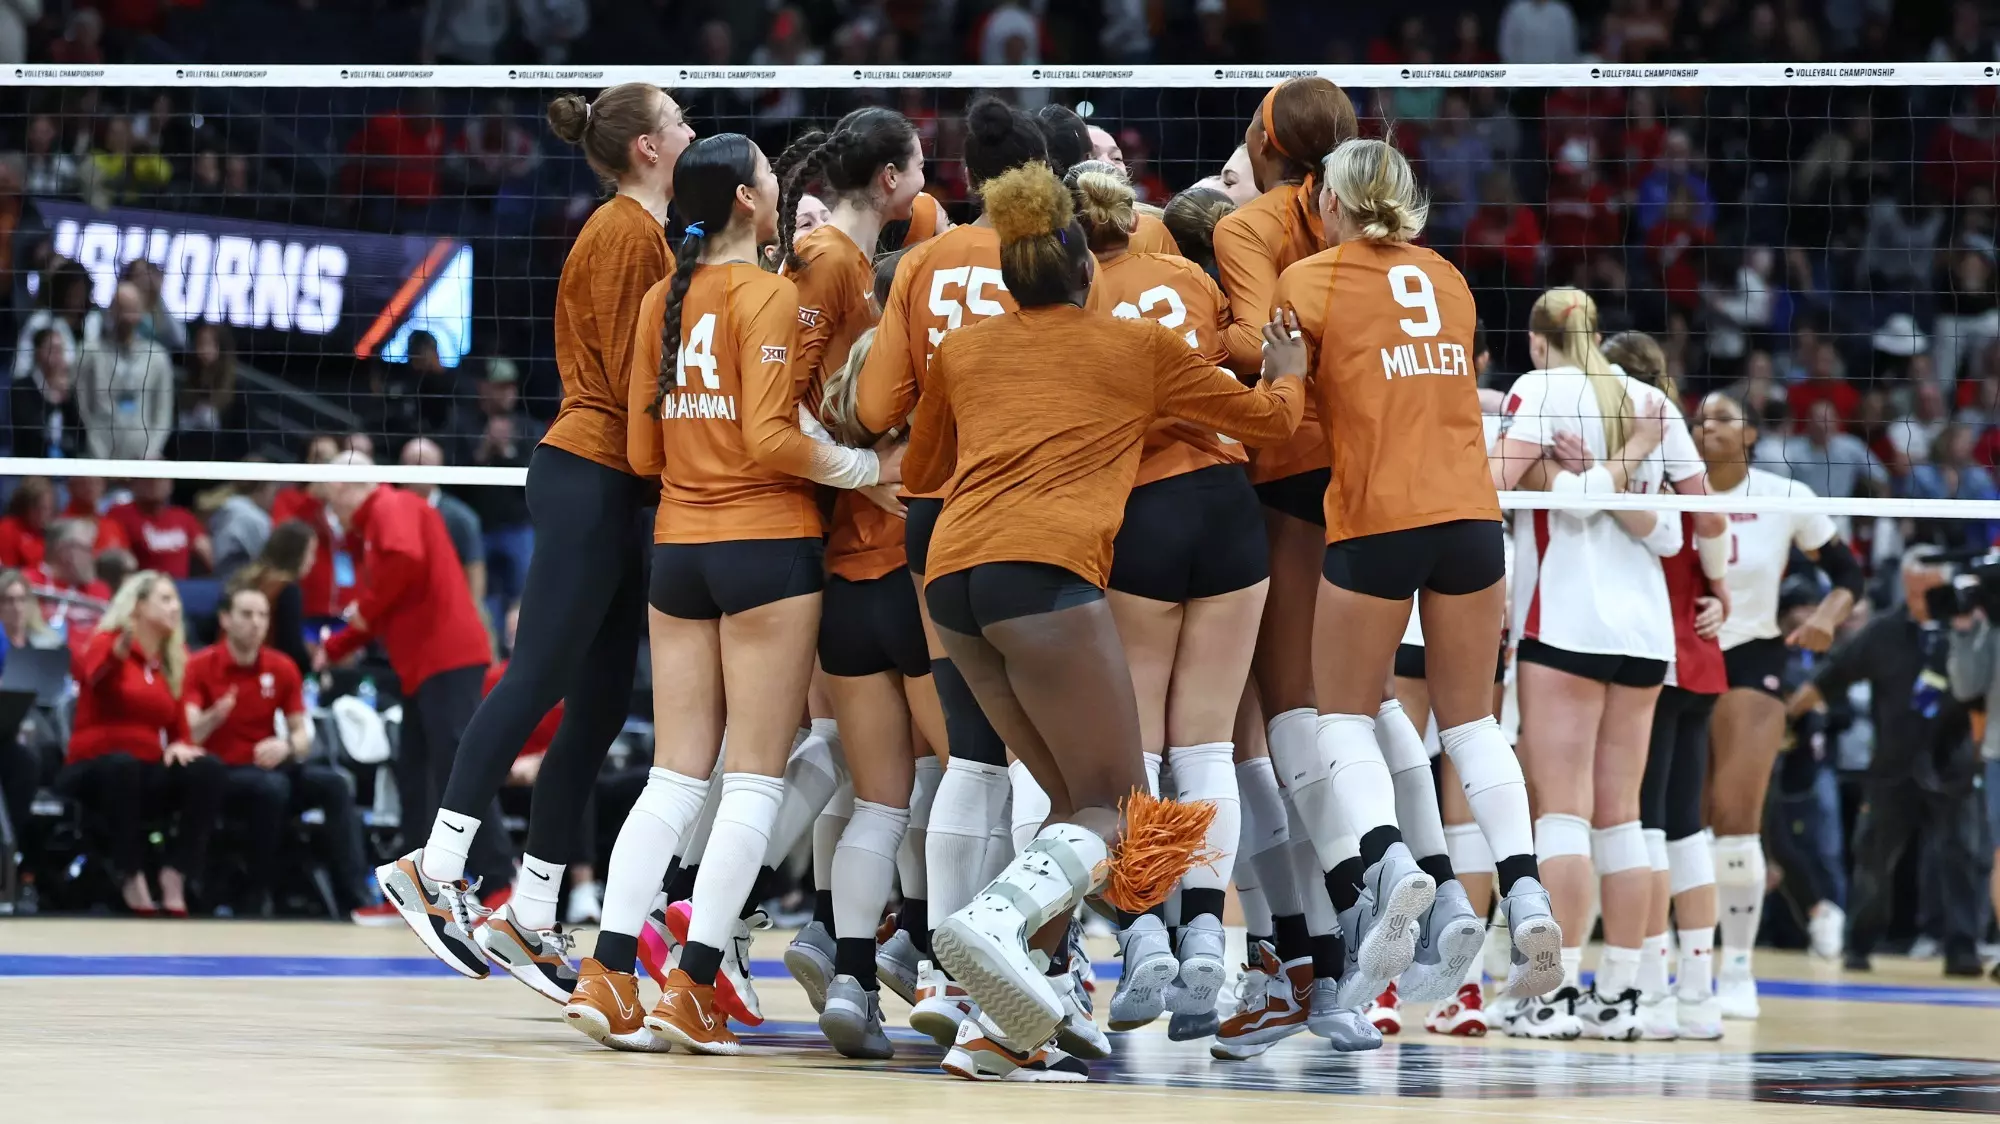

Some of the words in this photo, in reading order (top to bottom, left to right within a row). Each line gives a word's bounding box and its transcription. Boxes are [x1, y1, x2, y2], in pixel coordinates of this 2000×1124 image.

[185, 70, 219, 78] VOLLEYBALL
[518, 71, 554, 79] VOLLEYBALL
[556, 71, 604, 79] CHAMPIONSHIP
[689, 71, 726, 79] VOLLEYBALL
[727, 71, 776, 79] CHAMPIONSHIP
[863, 71, 901, 79] VOLLEYBALL
[903, 71, 952, 79] CHAMPIONSHIP
[1042, 70, 1080, 79] VOLLEYBALL
[1082, 71, 1133, 79] CHAMPIONSHIP
[1225, 70, 1264, 79] VOLLEYBALL
[1266, 70, 1318, 78] CHAMPIONSHIP
[1412, 70, 1452, 79] VOLLEYBALL
[1453, 70, 1506, 78] CHAMPIONSHIP
[1601, 69, 1643, 78] VOLLEYBALL
[1644, 69, 1699, 78] CHAMPIONSHIP
[1796, 68, 1837, 77] VOLLEYBALL
[1839, 68, 1895, 77] CHAMPIONSHIP
[1387, 264, 1442, 337] 9
[1111, 284, 1199, 349] 2
[762, 346, 787, 363] XII
[1380, 343, 1468, 380] MILLER
[661, 393, 736, 420] AHAHAWAI
